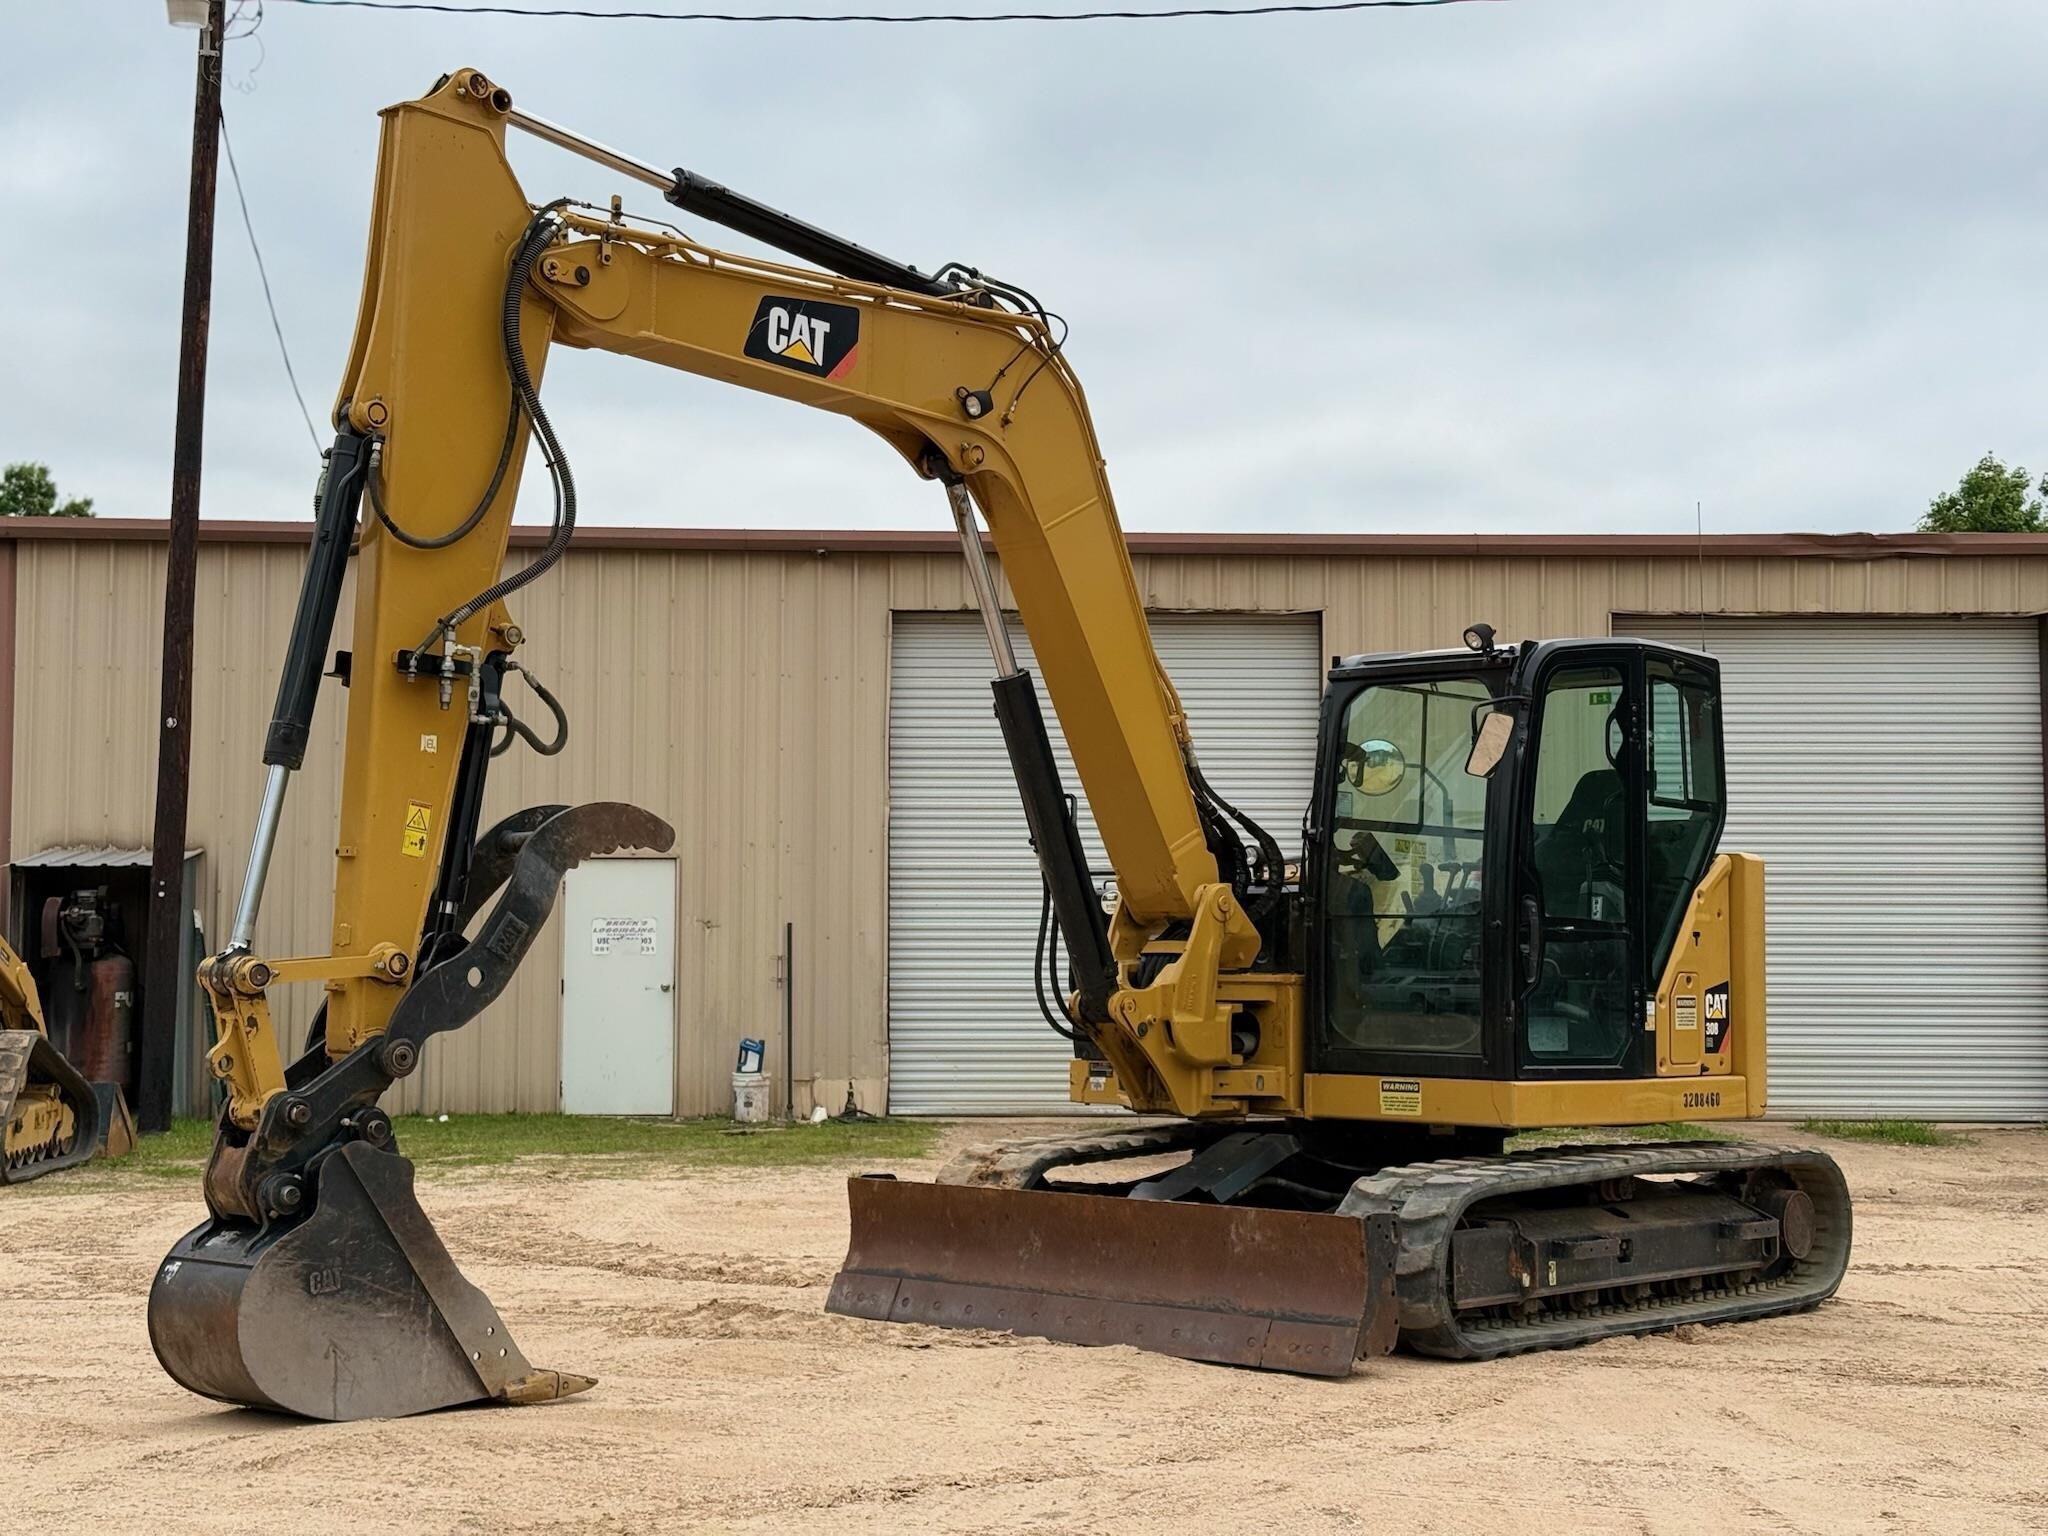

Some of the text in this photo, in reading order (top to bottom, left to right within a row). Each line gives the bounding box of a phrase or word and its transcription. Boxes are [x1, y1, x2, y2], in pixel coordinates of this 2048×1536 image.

[767, 306, 831, 367] CAT
[1705, 993, 1728, 1019] CAT
[1705, 1022, 1719, 1035] 308
[1382, 1082, 1419, 1091] WARNING
[1683, 1092, 1721, 1108] 3208460
[309, 1267, 343, 1295] CAT
